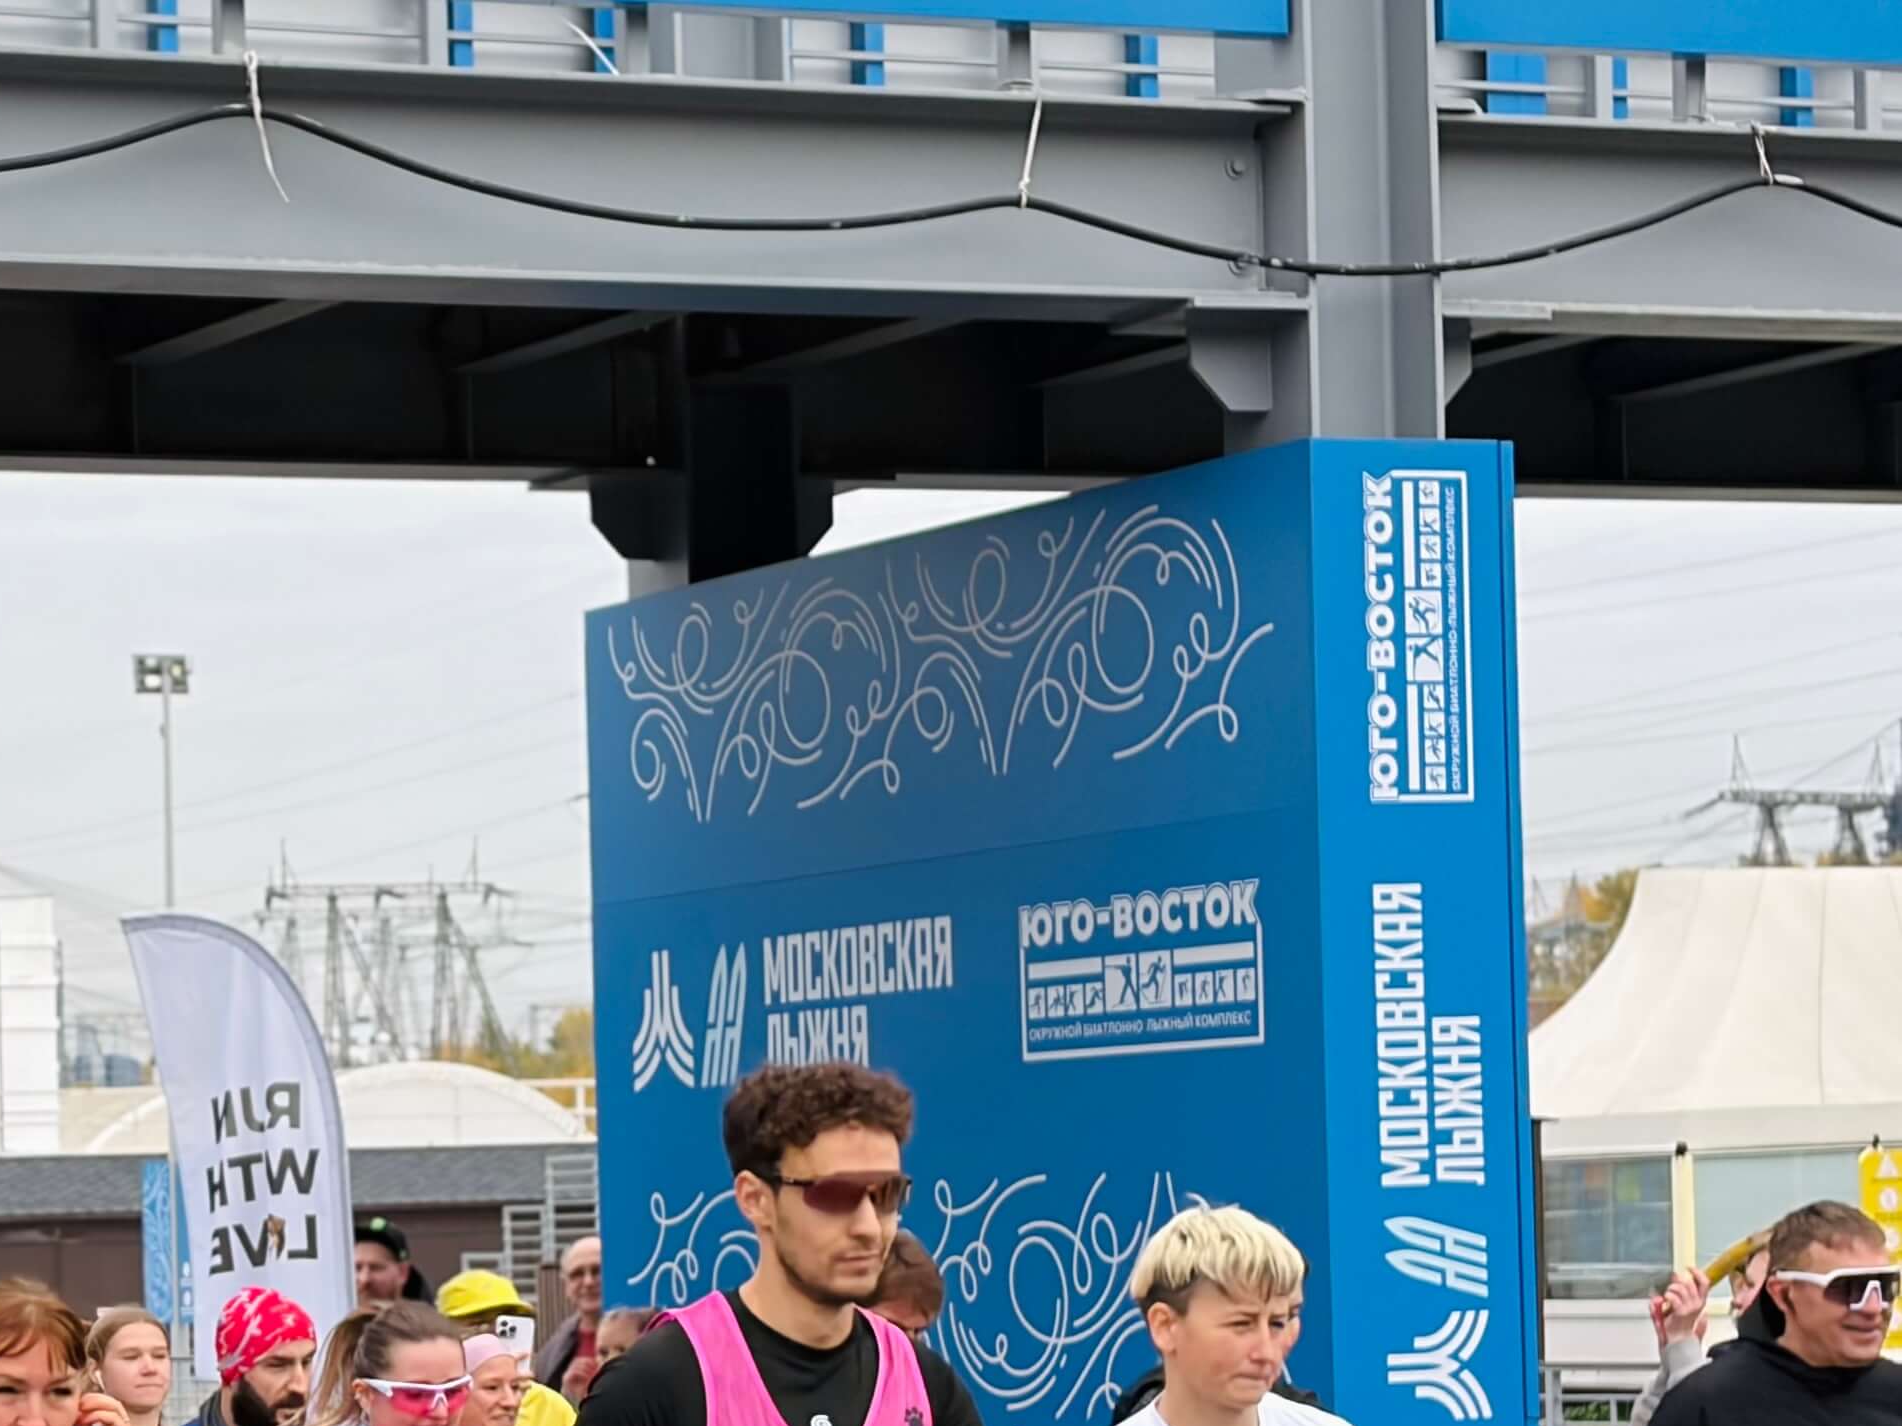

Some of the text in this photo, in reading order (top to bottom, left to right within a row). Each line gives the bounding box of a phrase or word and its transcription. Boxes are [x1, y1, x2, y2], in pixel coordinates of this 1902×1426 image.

[1363, 471, 1399, 801] ЮГО-ВОСТОК
[763, 915, 953, 1006] МОСКОВСКАЯ
[1019, 879, 1259, 947] ЮГО-ВОСТОК
[1372, 882, 1430, 1188] МОСКОВСКАЯ
[1431, 1015, 1485, 1186] ЛЫЖНЯ
